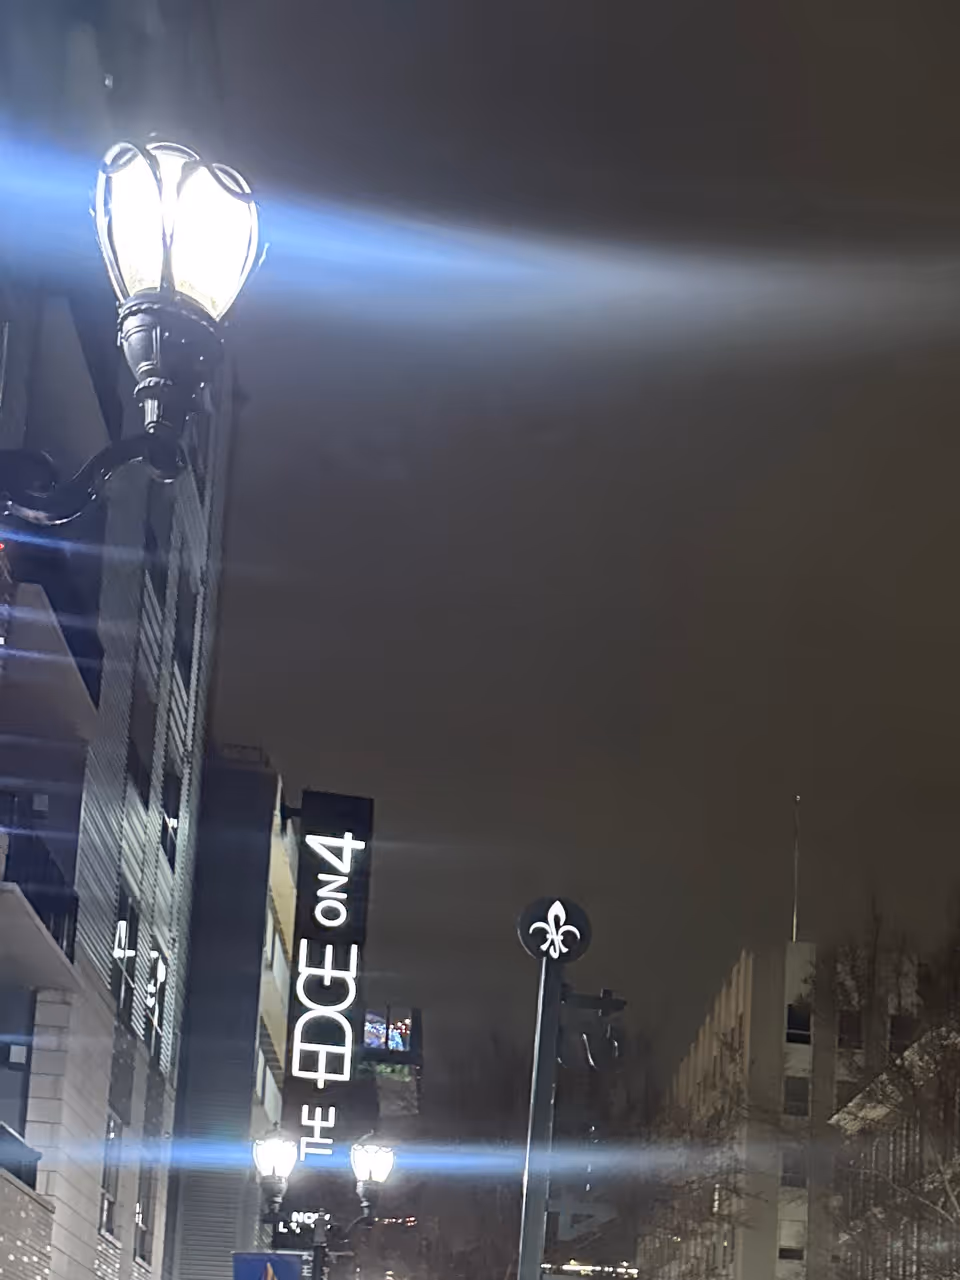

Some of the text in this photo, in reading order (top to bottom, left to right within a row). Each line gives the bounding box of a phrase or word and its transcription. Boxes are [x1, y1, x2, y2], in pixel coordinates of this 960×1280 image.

[314, 873, 348, 927] ON
[292, 938, 358, 1089] EDGE
[300, 1104, 336, 1161] THE
